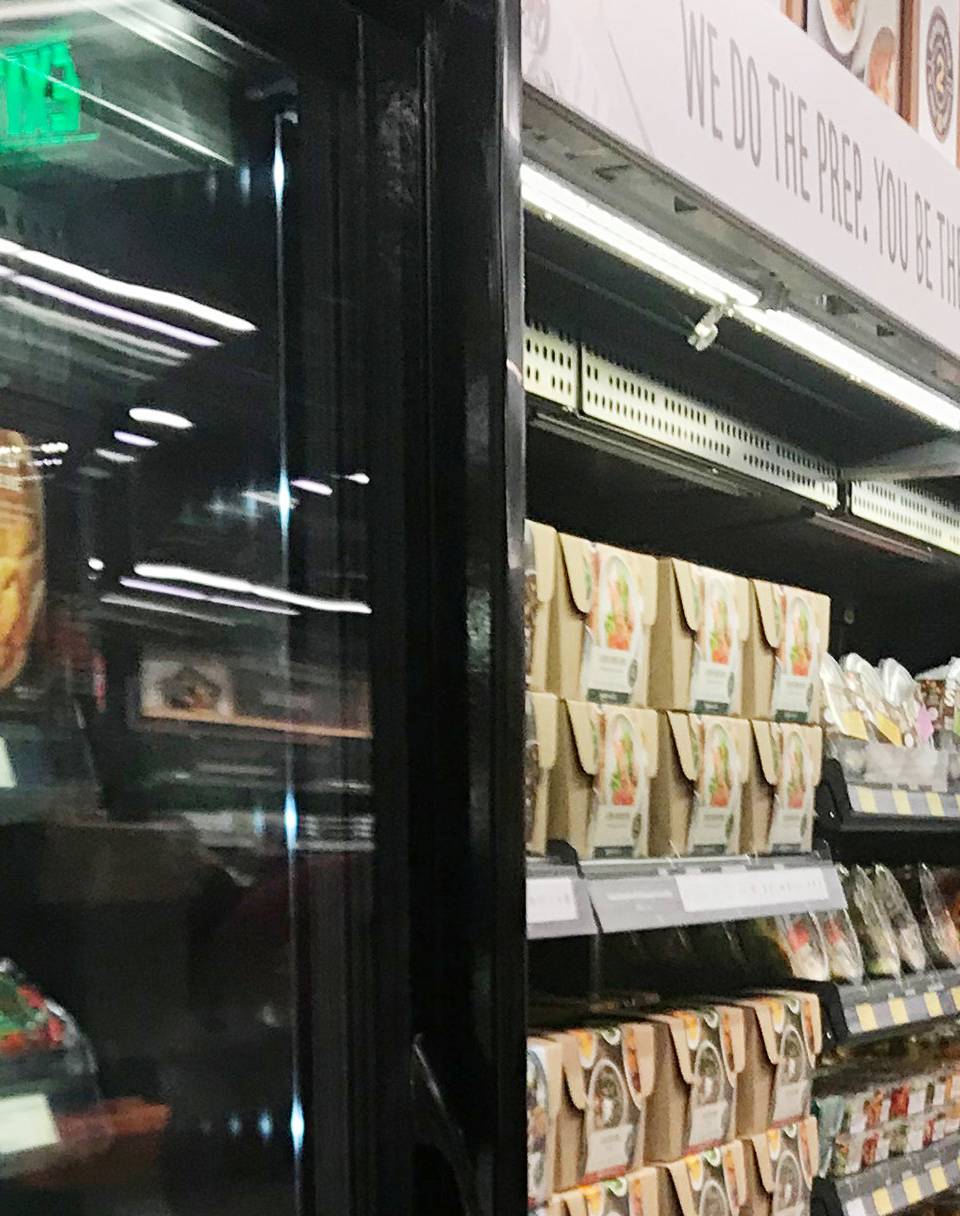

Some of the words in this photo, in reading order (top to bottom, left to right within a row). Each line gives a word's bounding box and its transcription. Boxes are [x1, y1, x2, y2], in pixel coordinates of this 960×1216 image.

[680, 0, 723, 142] WE
[729, 36, 761, 168] DO
[767, 71, 810, 203] THE
[816, 110, 868, 244] PREP.
[873, 156, 909, 272] YOU
[915, 190, 933, 291] BE
